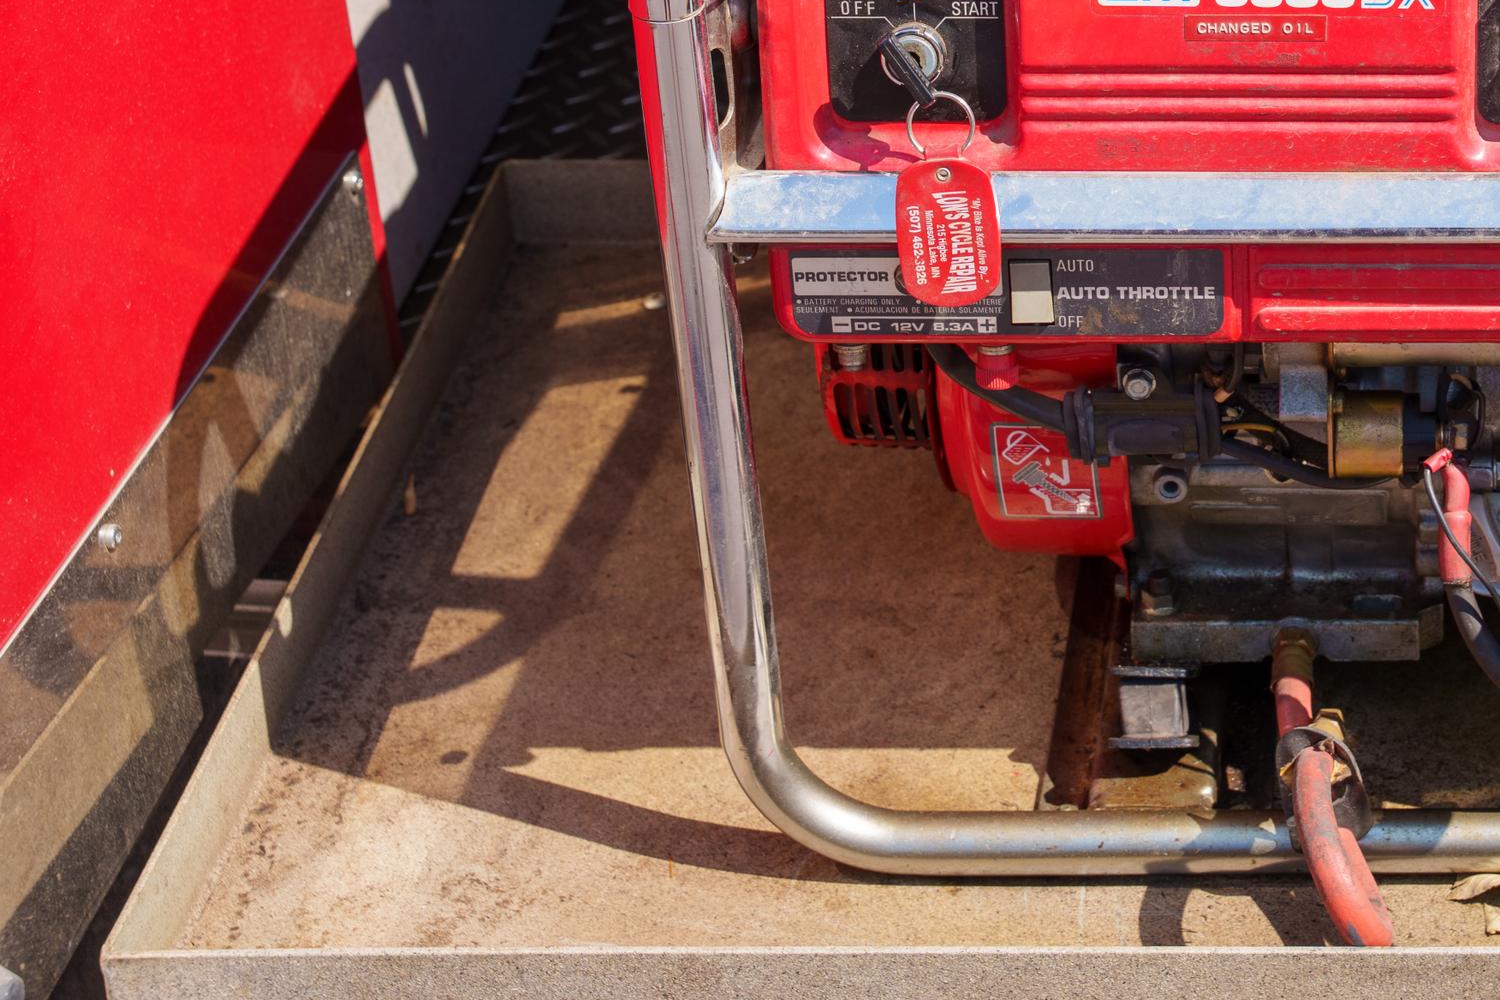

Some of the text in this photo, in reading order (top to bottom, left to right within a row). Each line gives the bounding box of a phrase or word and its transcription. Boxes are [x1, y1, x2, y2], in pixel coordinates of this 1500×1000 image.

[840, 1, 876, 16] OFF
[951, 0, 998, 17] START
[1197, 21, 1315, 36] CHANGED OIL
[906, 205, 922, 233] (507)
[925, 210, 941, 279] Minnesota Lake, MN
[936, 223, 948, 262] 215 Higbee
[948, 221, 974, 254] CYCLE
[1057, 260, 1094, 272] AUTO
[795, 271, 889, 283] PROTECTOR
[941, 255, 977, 294] REPAIR
[1058, 286, 1216, 300] AUTO THROTTLE
[796, 306, 839, 314] SEULEMENT
[855, 306, 908, 314] ACUMULACION
[924, 306, 955, 314] BATERIA
[958, 306, 1003, 314] SOLAMENTE
[854, 321, 975, 332] DC 12V 8.3A
[1058, 315, 1084, 327] OFF
